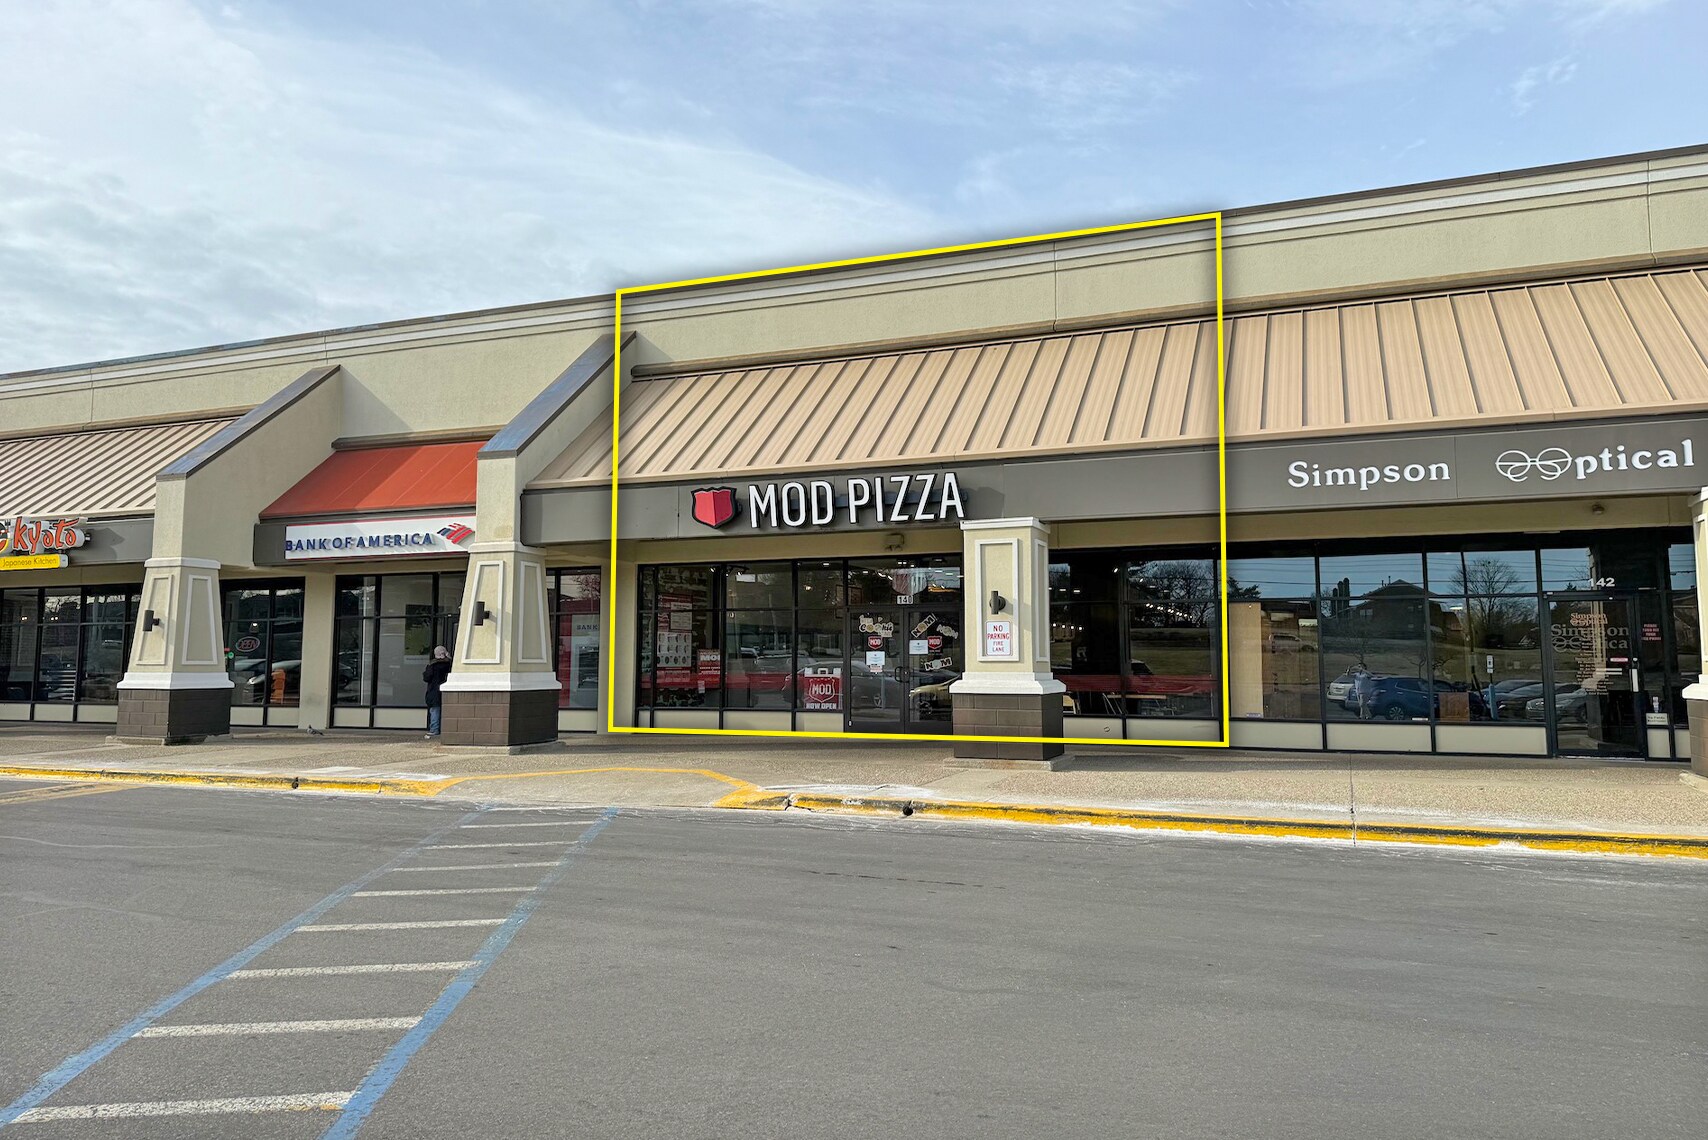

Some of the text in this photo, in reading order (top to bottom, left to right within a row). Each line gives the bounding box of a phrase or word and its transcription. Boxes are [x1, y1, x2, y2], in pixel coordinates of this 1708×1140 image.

[1287, 459, 1451, 491] Simpson
[749, 472, 965, 528] MOD PIZZA
[13, 516, 80, 554] kyoto
[285, 532, 434, 551] BANK OF AMERICA
[2, 557, 57, 568] Japanese Kitchen
[1588, 577, 1616, 587] 142
[812, 683, 832, 695] MOD
[806, 702, 837, 710] NOW OPEN
